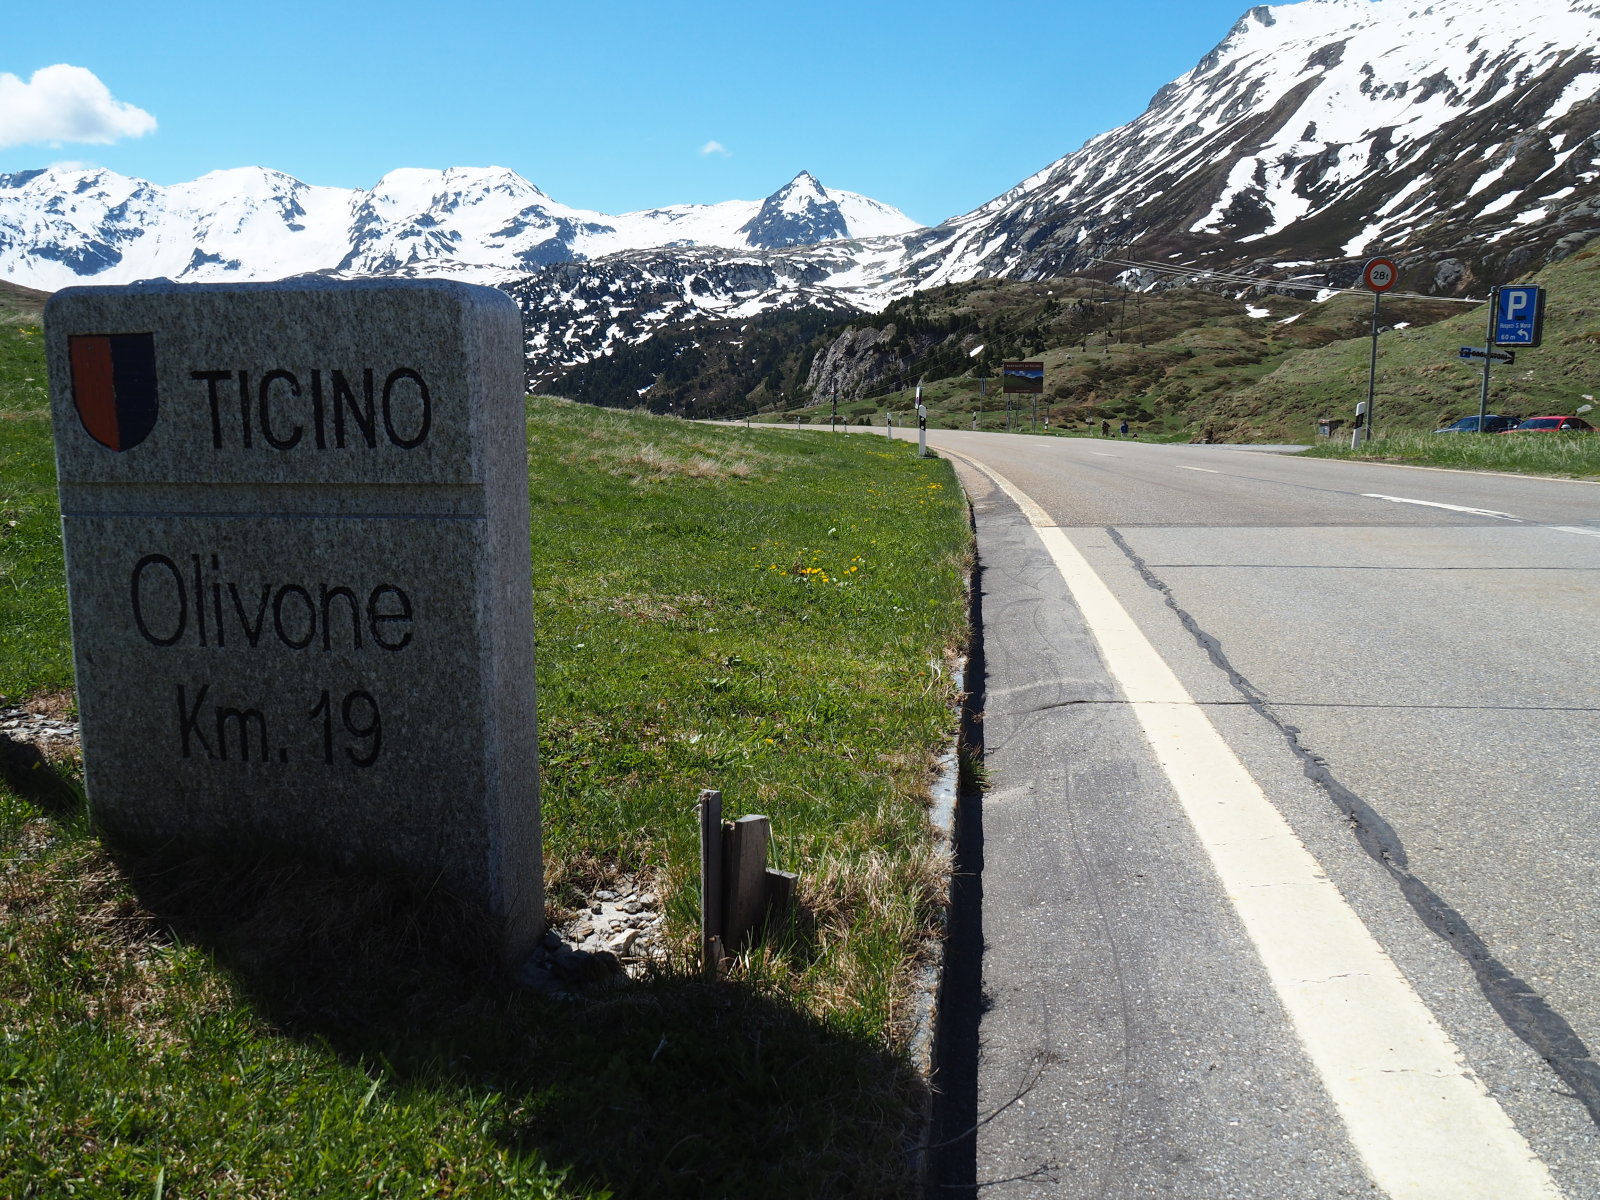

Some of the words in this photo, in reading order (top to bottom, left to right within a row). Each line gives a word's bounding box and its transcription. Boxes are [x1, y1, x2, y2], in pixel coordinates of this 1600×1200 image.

[1507, 291, 1527, 320] P
[190, 367, 432, 450] TICINO
[130, 553, 413, 651] Olivone
[176, 683, 288, 763] Km.
[308, 689, 383, 768] 19
